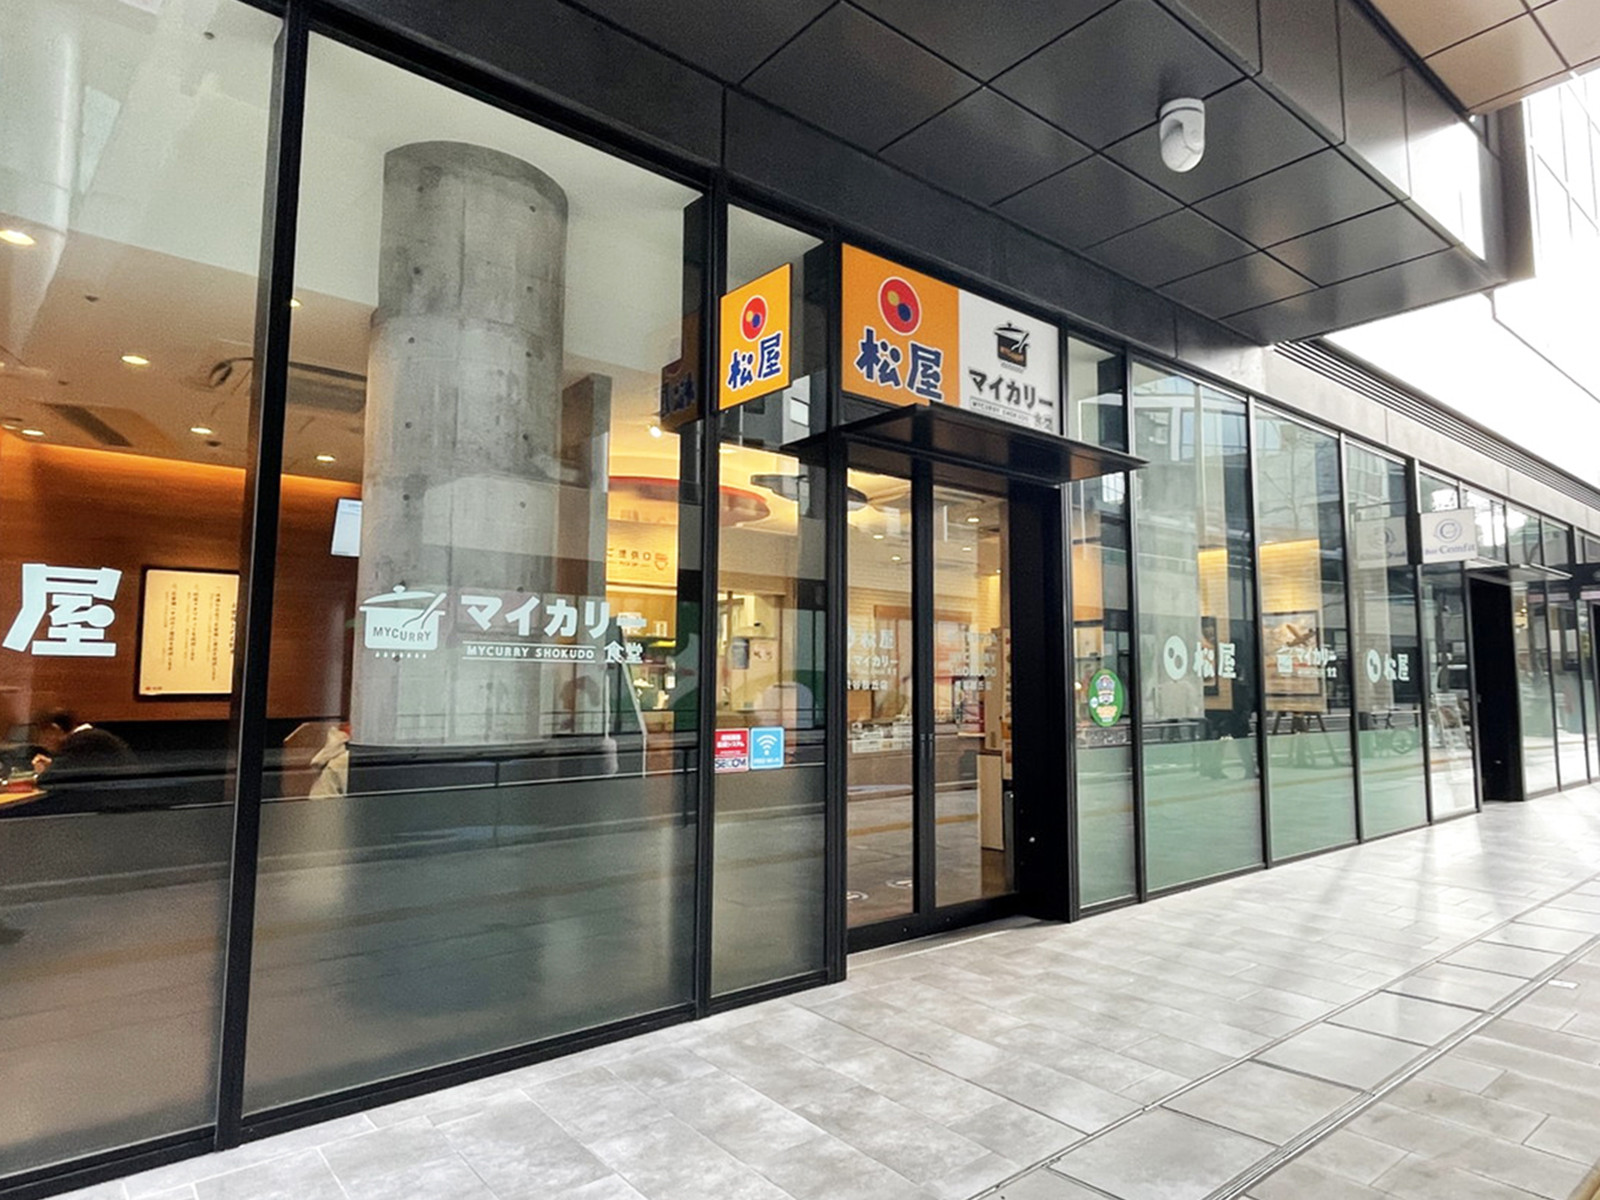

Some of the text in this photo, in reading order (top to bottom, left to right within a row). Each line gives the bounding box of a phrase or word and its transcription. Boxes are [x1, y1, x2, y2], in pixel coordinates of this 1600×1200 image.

[727, 331, 782, 390] 松屋
[854, 327, 943, 401] 松屋
[969, 368, 1054, 410] マイカリー
[2, 563, 122, 656] 屋
[461, 595, 647, 639] マイカリー
[373, 627, 431, 642] MYCURRY
[466, 640, 644, 663] MYCURRY SHOKUDO 食堂
[1193, 641, 1236, 678] 松屋
